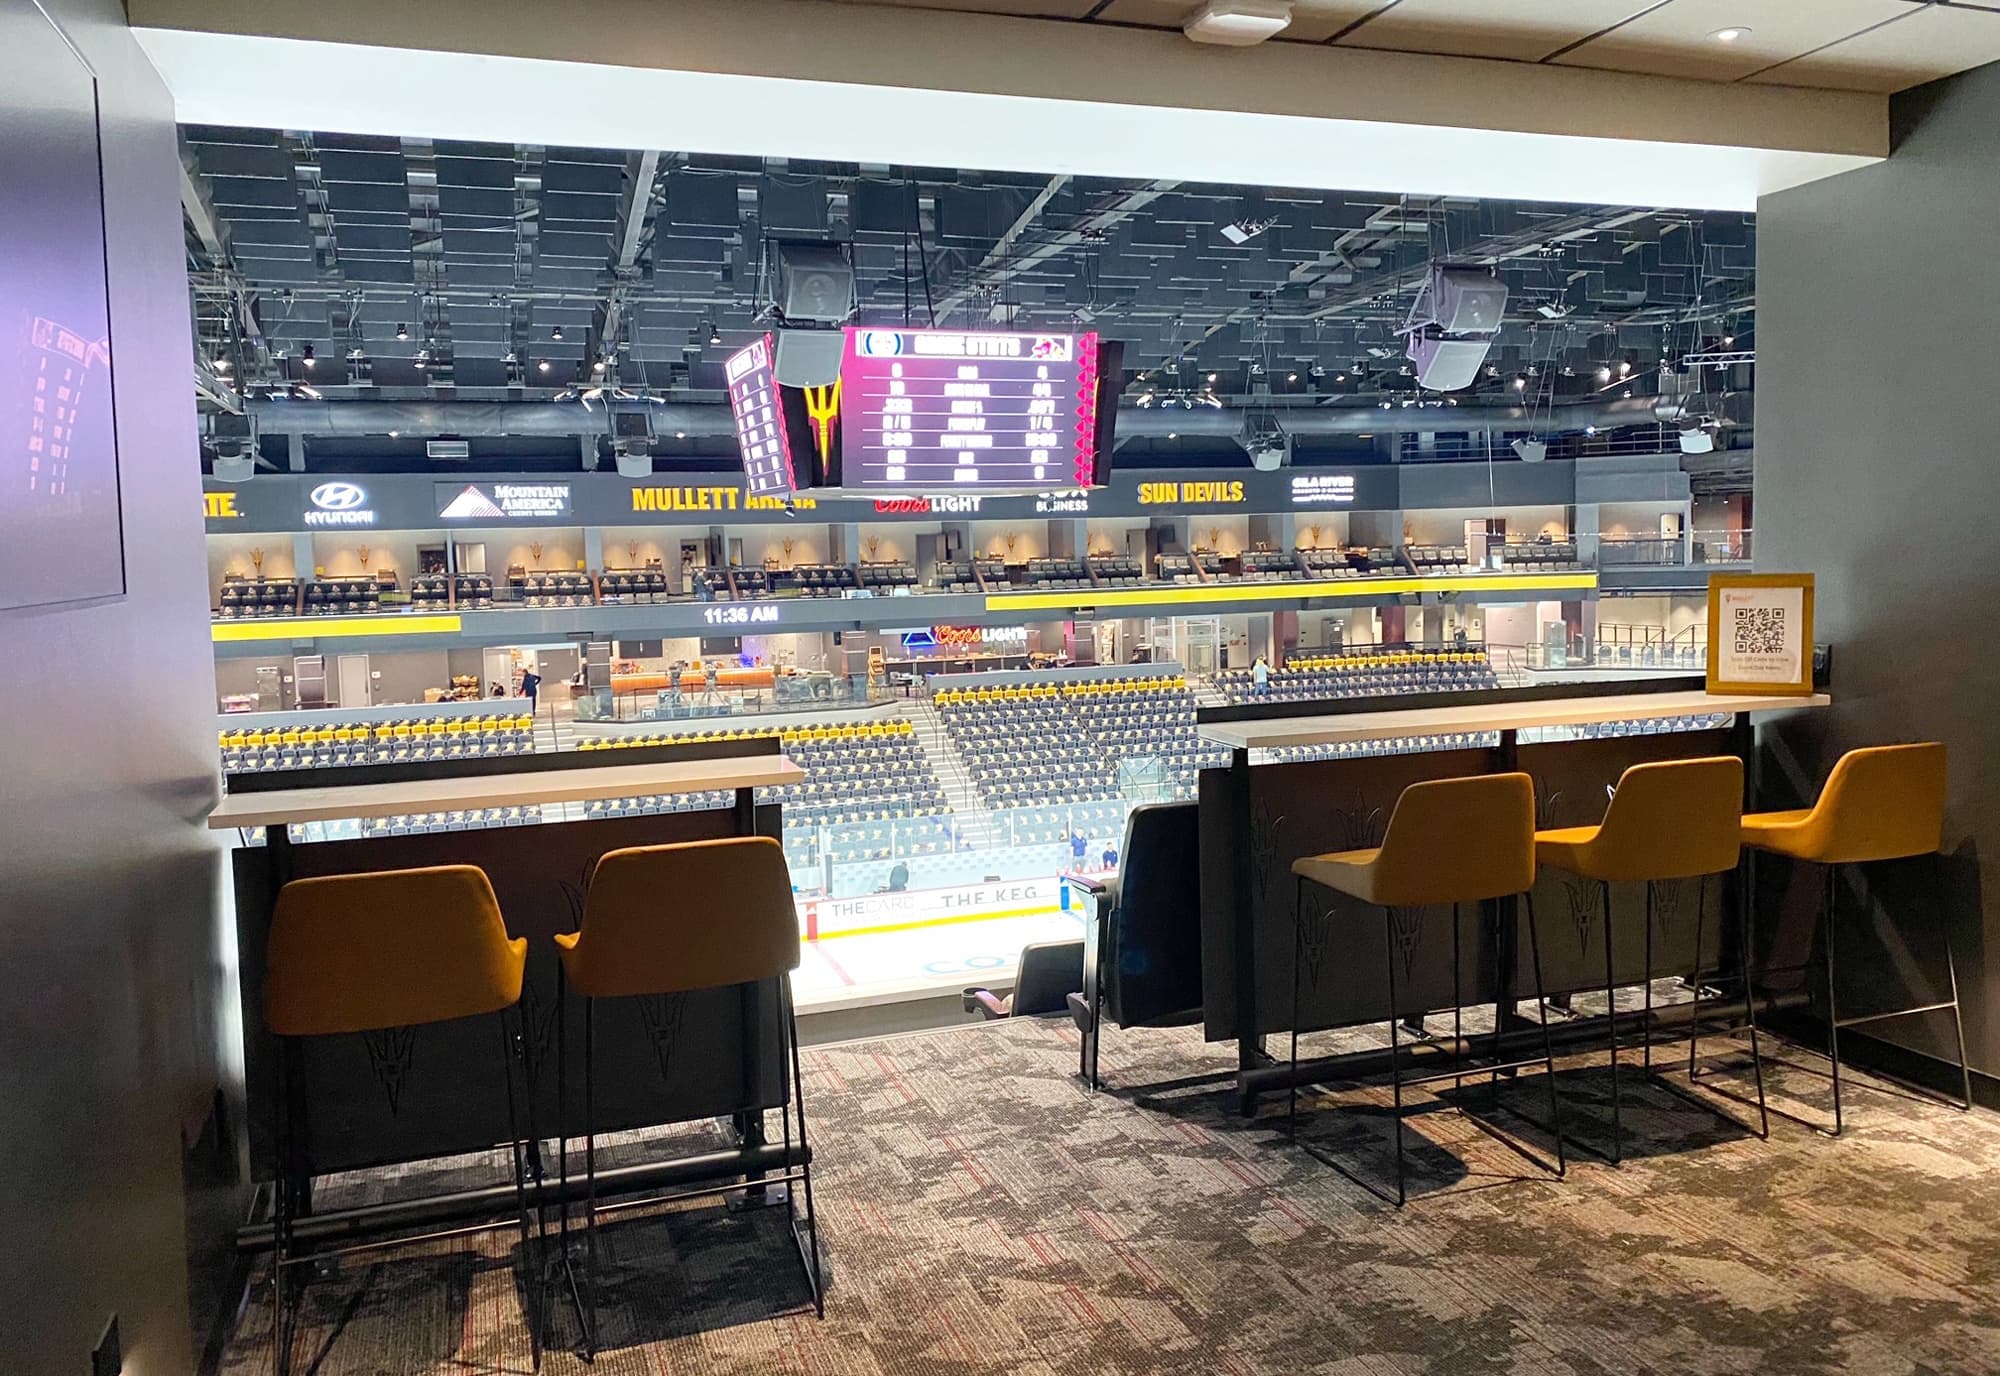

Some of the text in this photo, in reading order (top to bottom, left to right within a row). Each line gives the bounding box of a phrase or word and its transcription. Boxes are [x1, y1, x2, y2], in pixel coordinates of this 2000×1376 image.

[494, 485, 569, 499] MOUNTAIN
[631, 487, 739, 511] MULLETT
[1138, 482, 1178, 504] SUN
[501, 498, 564, 511] AMERICA
[931, 496, 982, 513] LIGHT
[304, 511, 374, 524] HYUNDAI
[704, 606, 779, 624] 11:36 AM
[935, 625, 1028, 644] Coors LIGHT
[941, 886, 1037, 908] THE KEG
